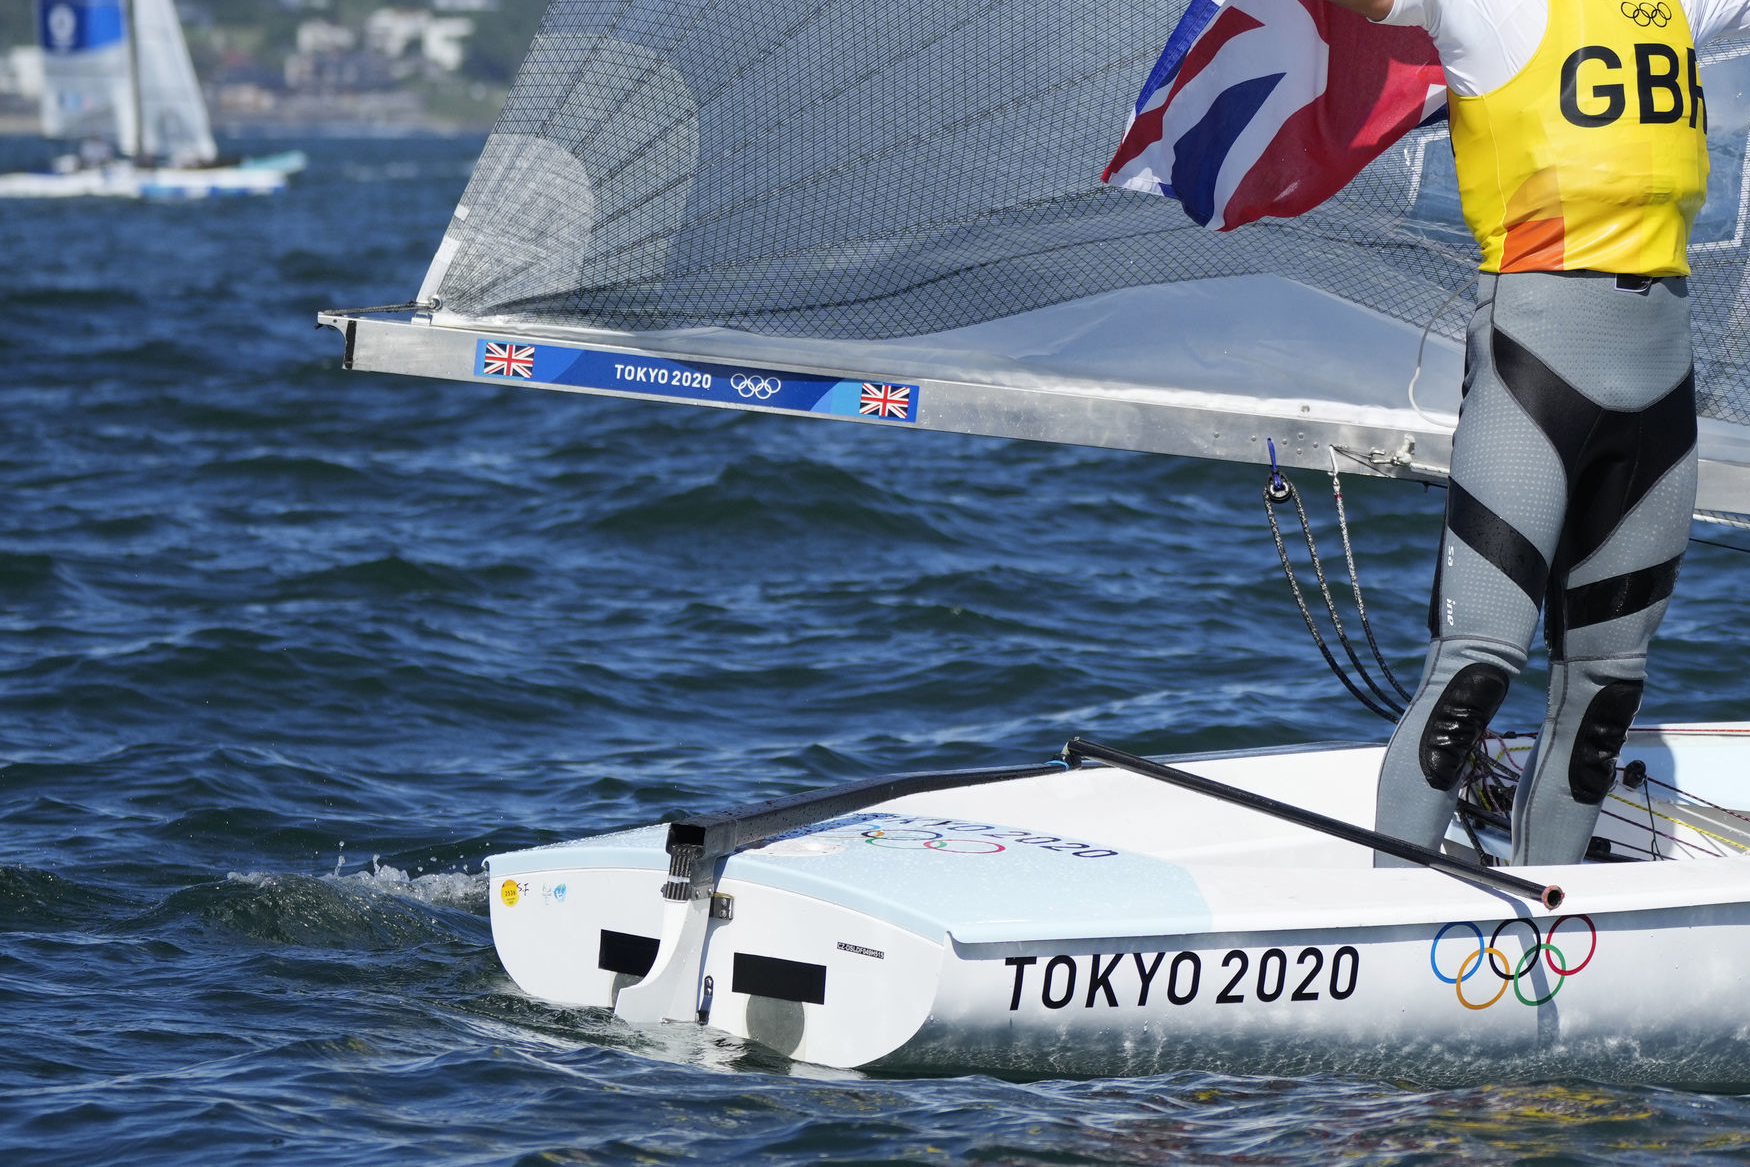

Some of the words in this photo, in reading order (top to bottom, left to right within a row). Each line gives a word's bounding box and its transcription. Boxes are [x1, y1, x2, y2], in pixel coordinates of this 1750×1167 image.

[614, 364, 668, 384] TOKYO
[671, 371, 712, 389] 2020
[981, 831, 1119, 858] 2020
[1005, 951, 1201, 1011] TOKYO
[1215, 946, 1360, 1004] 2020
